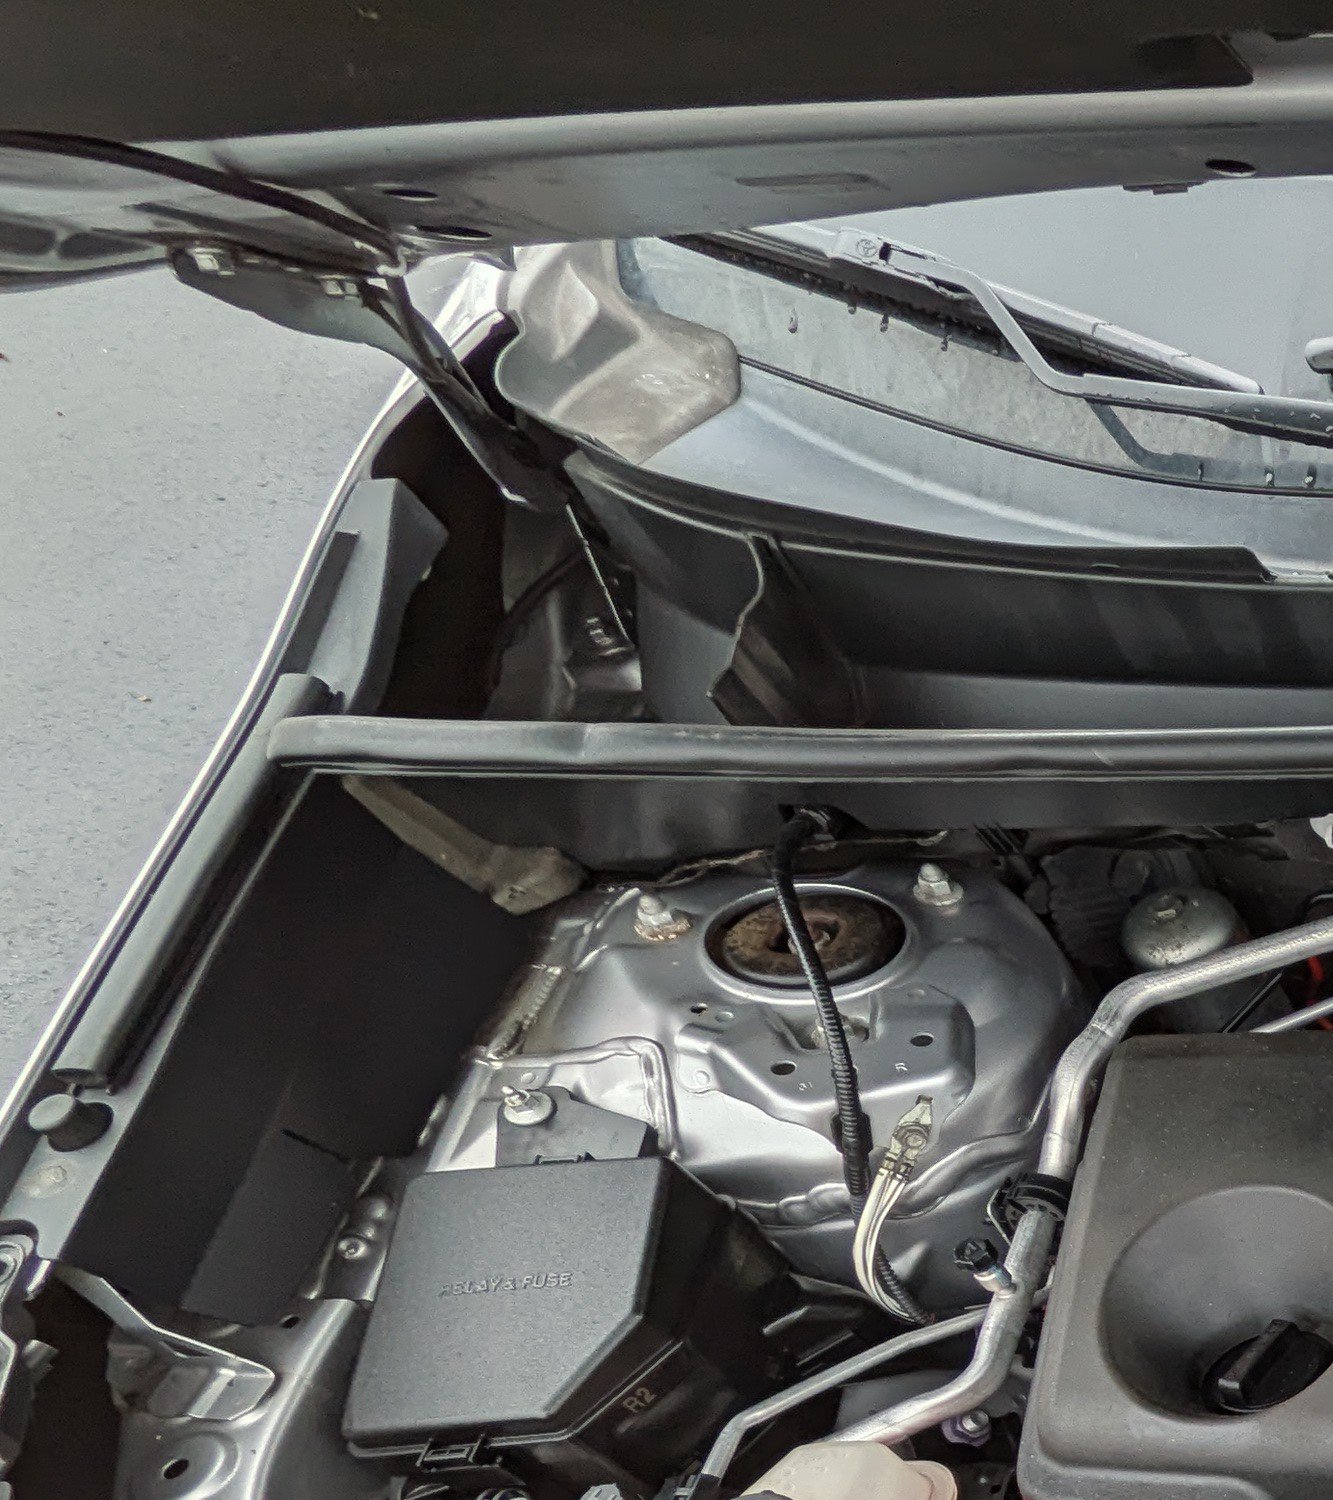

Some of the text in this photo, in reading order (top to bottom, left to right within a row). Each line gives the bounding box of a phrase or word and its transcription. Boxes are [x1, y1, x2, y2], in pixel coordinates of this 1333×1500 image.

[438, 1276, 503, 1298] RELAY
[522, 1272, 573, 1290] FUSE
[622, 1387, 658, 1413] R2
